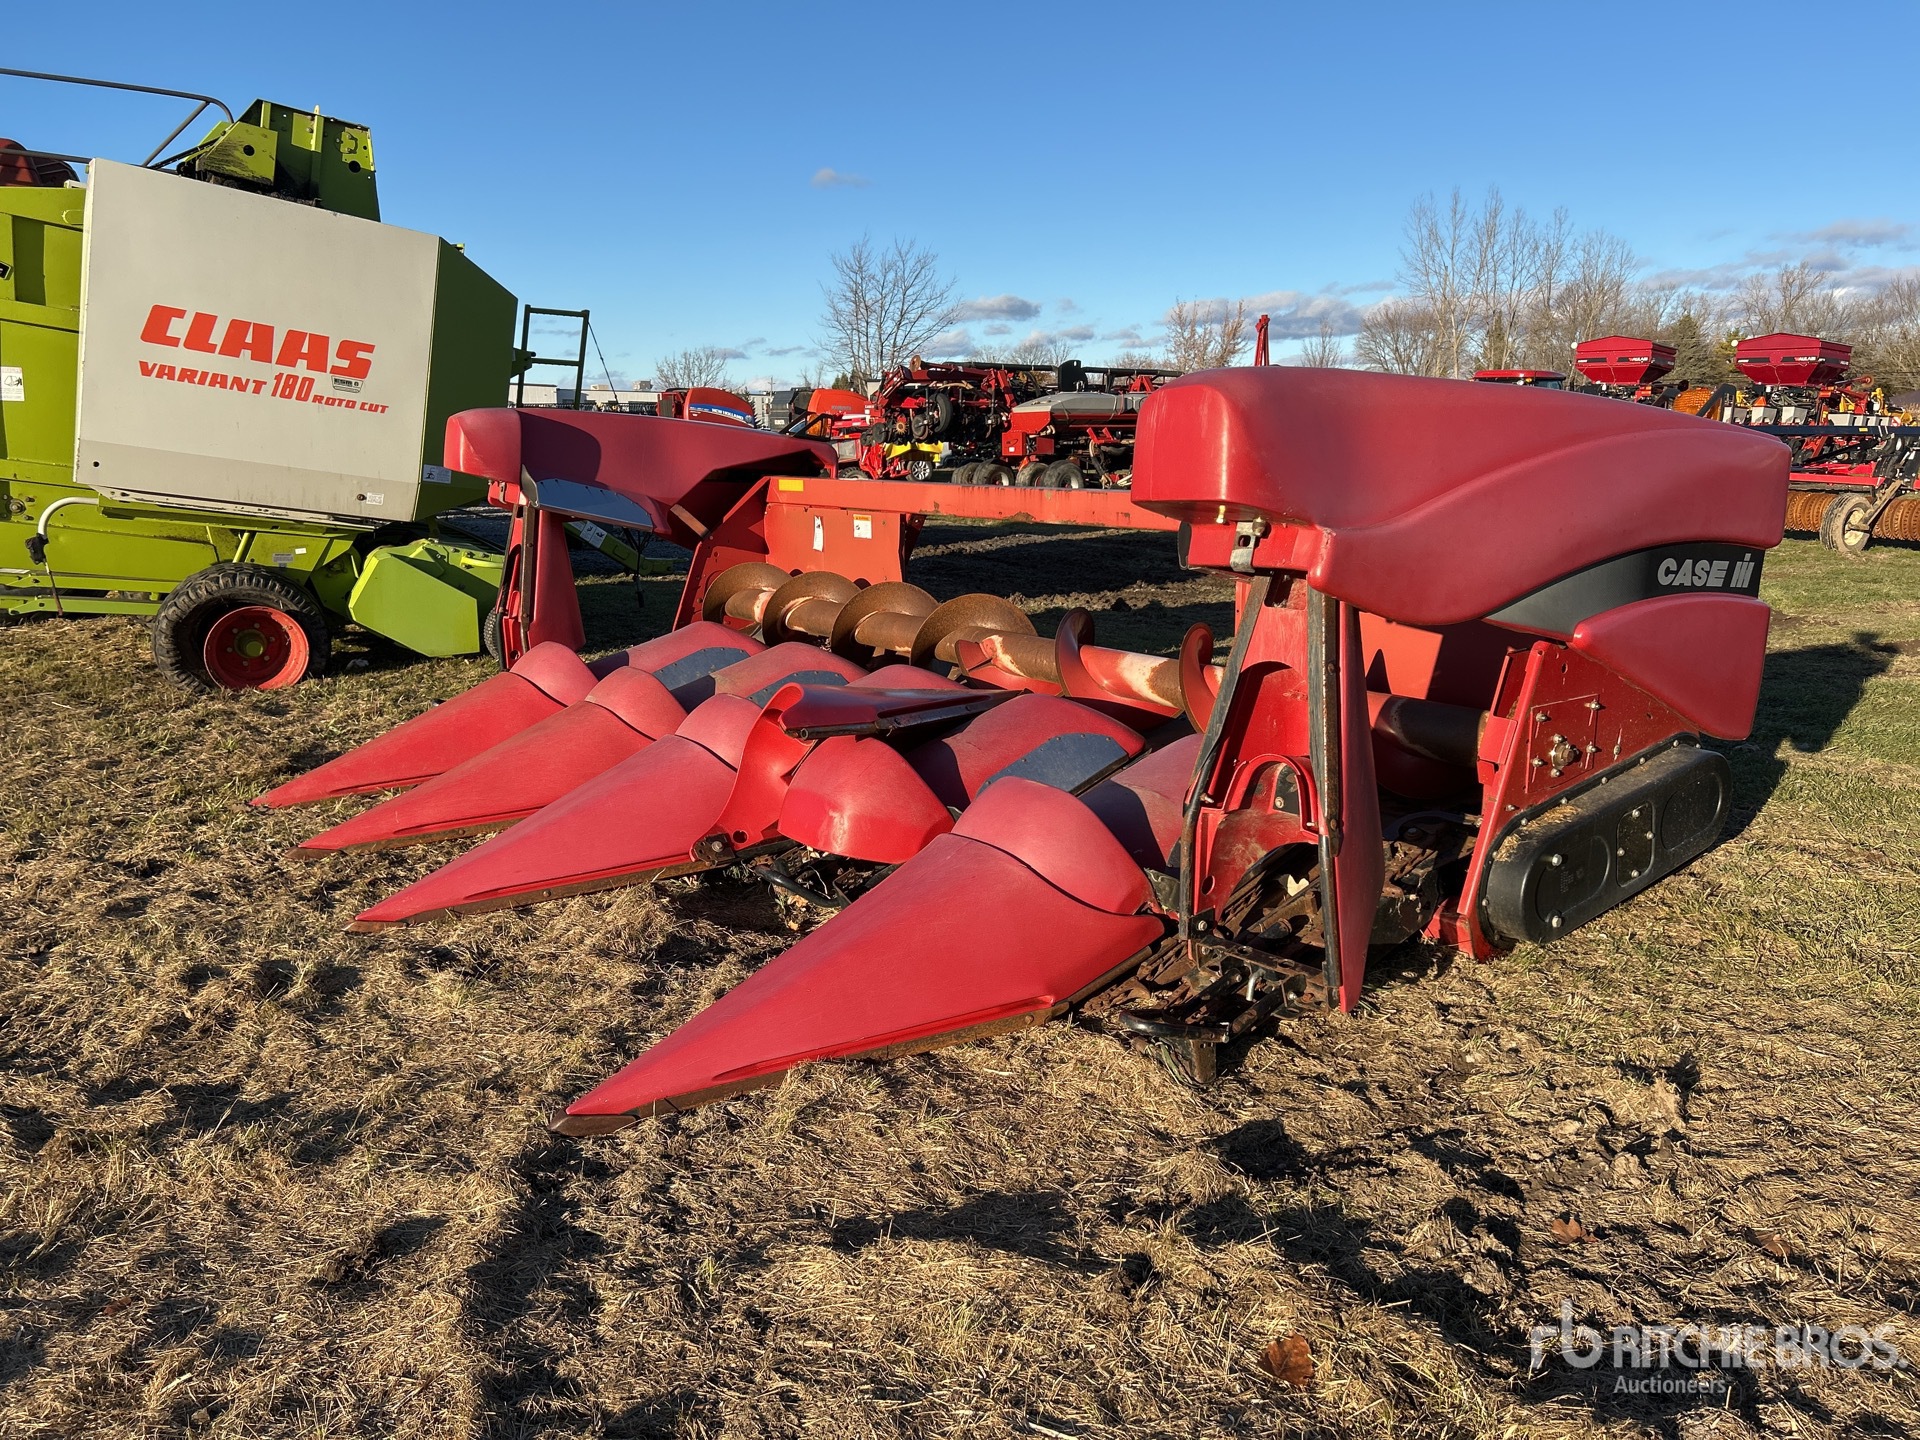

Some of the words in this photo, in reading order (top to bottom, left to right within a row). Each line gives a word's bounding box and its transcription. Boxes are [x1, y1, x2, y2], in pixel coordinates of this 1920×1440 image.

[140, 304, 376, 380] CLAAS
[138, 360, 267, 395] VARIANT
[271, 372, 316, 402] 180
[312, 394, 358, 410] ROTO
[359, 402, 389, 414] CUT
[1657, 557, 1730, 588] CASE
